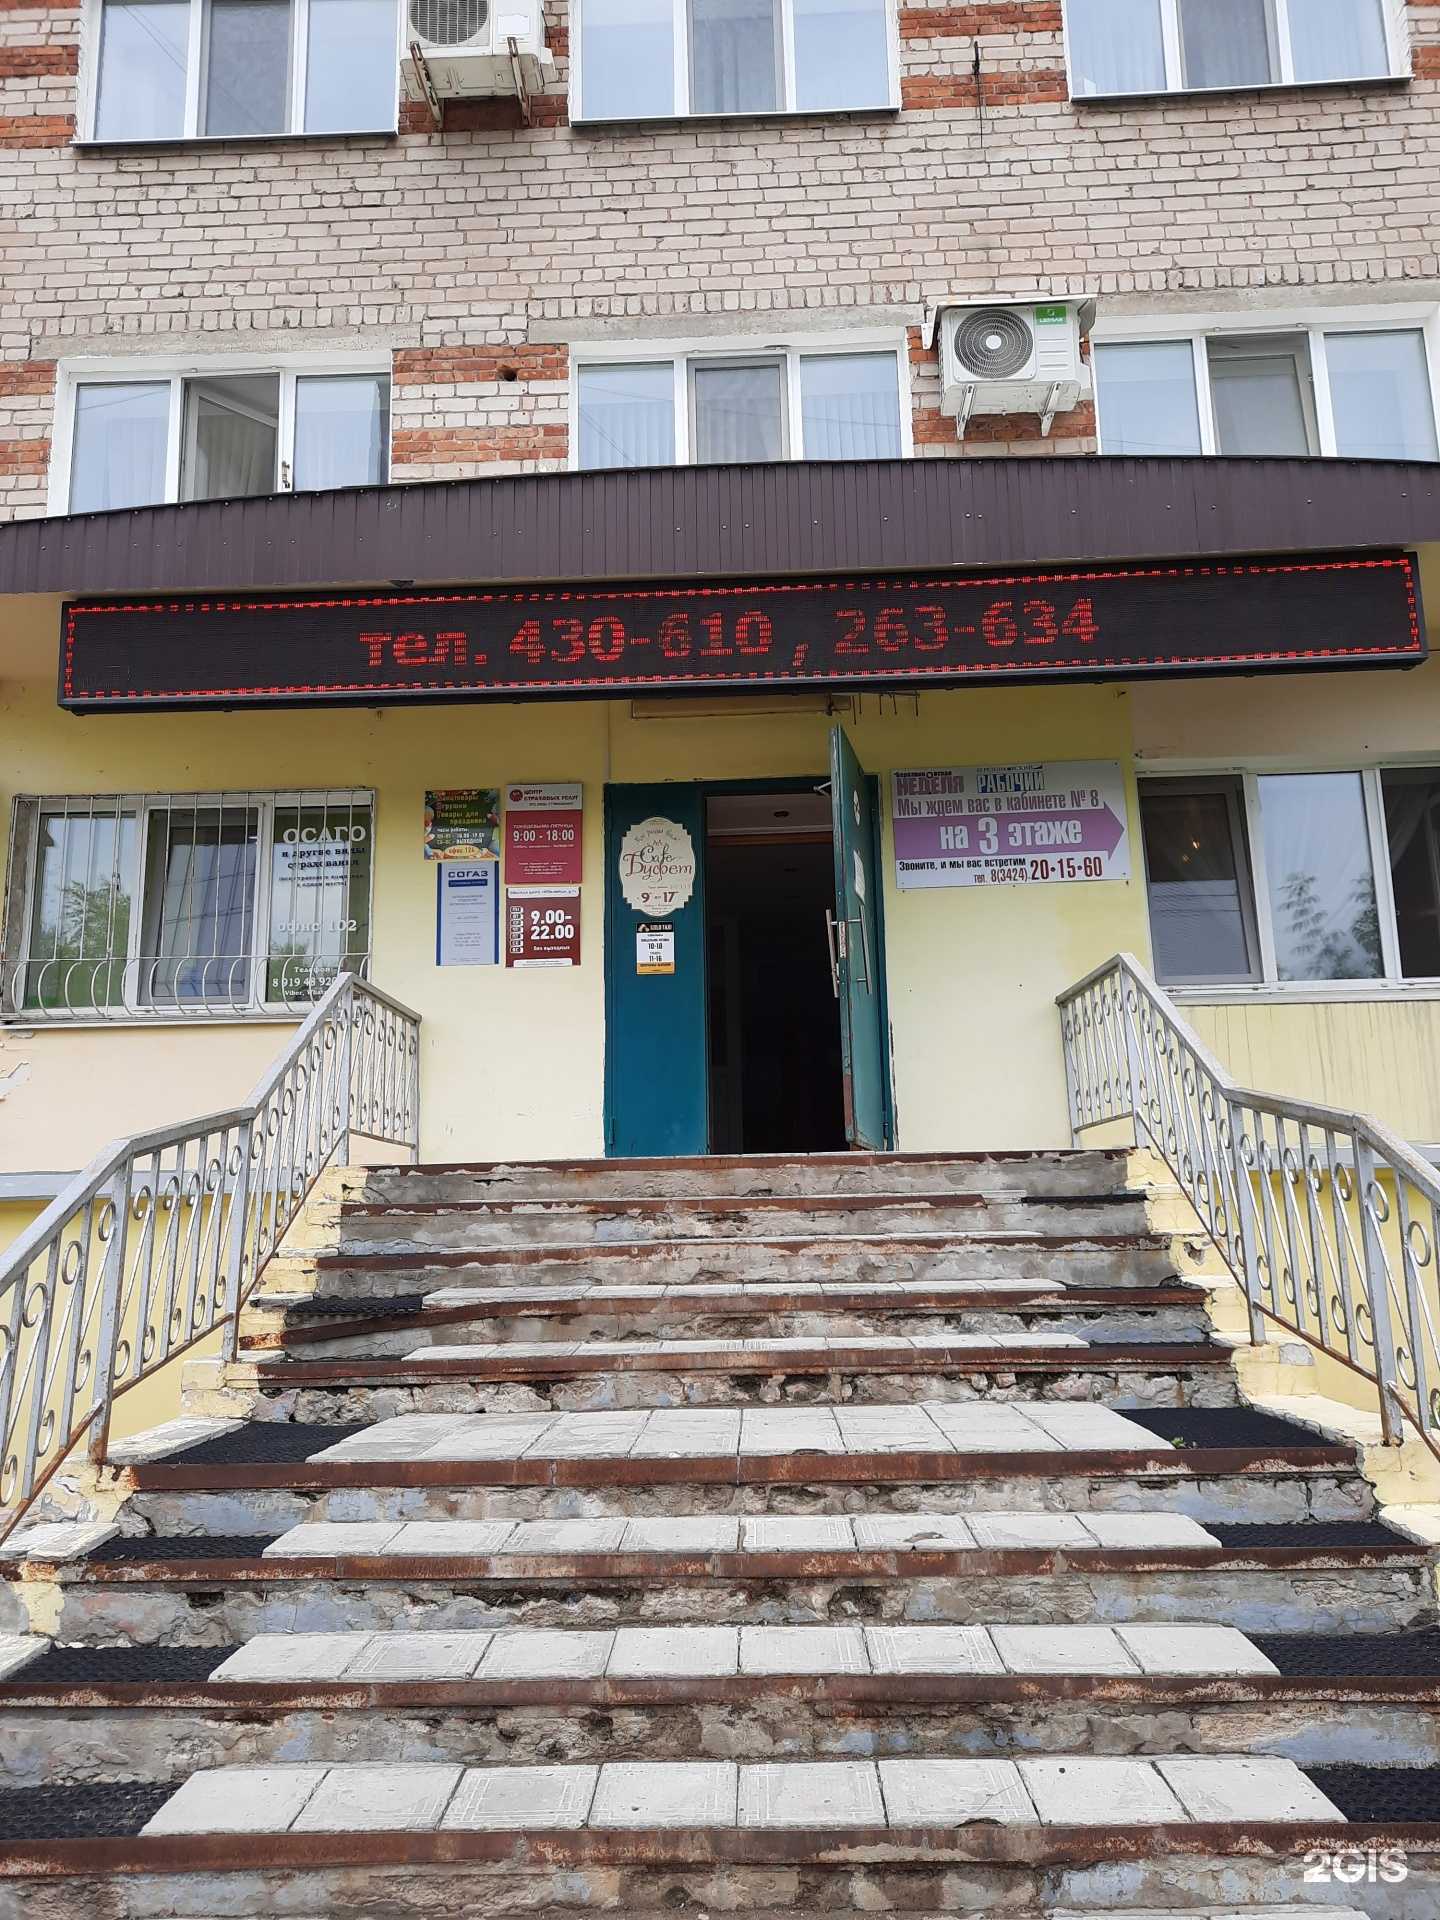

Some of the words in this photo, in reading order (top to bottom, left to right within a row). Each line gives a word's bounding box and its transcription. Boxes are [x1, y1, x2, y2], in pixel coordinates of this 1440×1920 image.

[359, 632, 487, 666] тел.
[509, 610, 773, 664] 430-610
[833, 598, 1100, 652] 263-634
[897, 799, 922, 816] Мы
[926, 799, 963, 816] ждем
[968, 799, 990, 813] вас
[995, 799, 1002, 812] в
[1006, 792, 1067, 811] кабинете
[1070, 790, 1086, 808] №
[1091, 789, 1099, 807] 8
[282, 825, 366, 844] ОСАГО
[513, 830, 536, 842] 9:00
[546, 829, 575, 841] 18:00
[940, 825, 969, 850] на
[977, 817, 999, 855] 3
[1007, 820, 1083, 847] этаже
[622, 850, 693, 880] Буфет
[899, 861, 938, 871] Звоните,
[949, 861, 965, 869] мы
[967, 860, 982, 868] вас
[984, 858, 1026, 868] встретим
[447, 870, 489, 878] СОГАЗ
[991, 867, 1028, 883] 8(3424)
[530, 909, 573, 925] 9.00-
[329, 919, 358, 932] 102
[530, 924, 575, 940] 22.00
